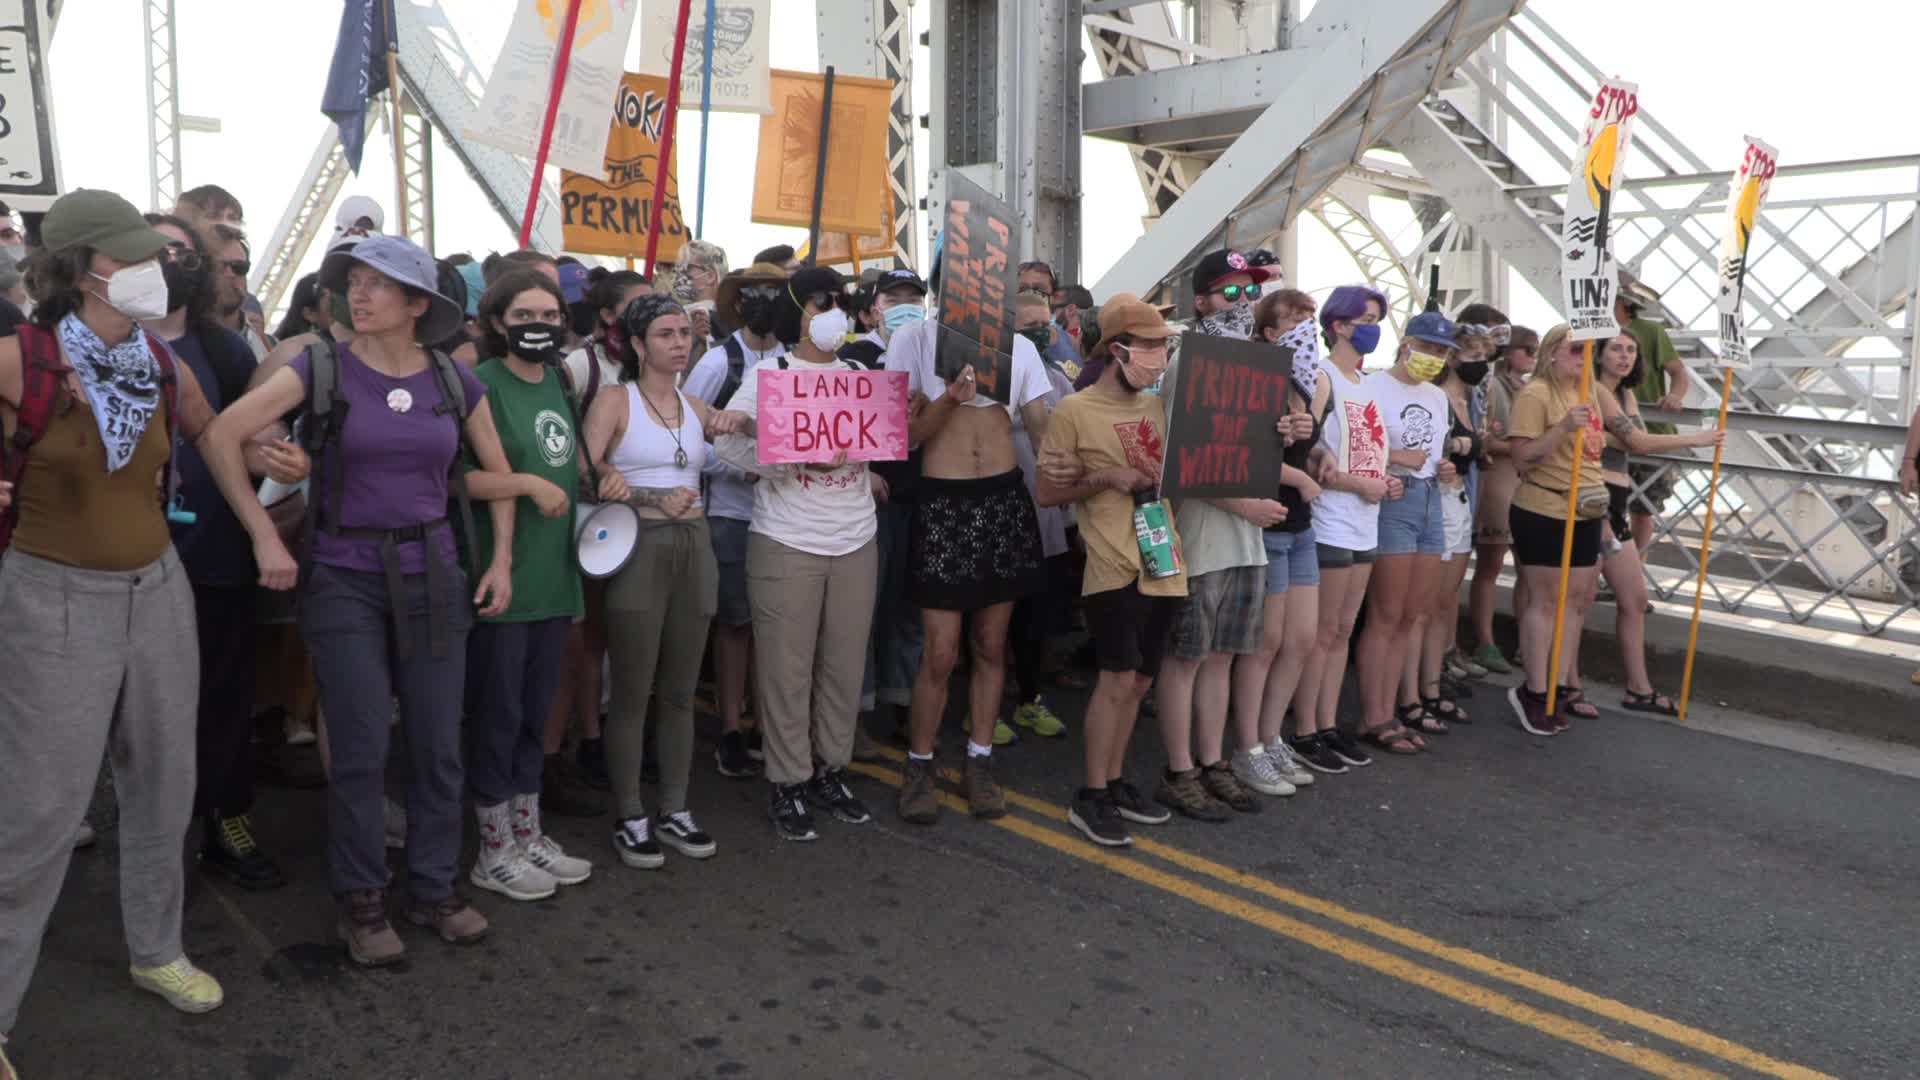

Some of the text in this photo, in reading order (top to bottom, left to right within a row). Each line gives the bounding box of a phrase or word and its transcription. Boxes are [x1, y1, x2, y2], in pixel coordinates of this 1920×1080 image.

[1591, 84, 1638, 125] STOP
[607, 160, 644, 184] THE
[1741, 143, 1776, 186] STOP
[944, 200, 970, 325] WATER
[965, 257, 983, 322] THE
[976, 216, 1009, 394] PROTECT
[793, 374, 873, 400] LAND
[1184, 353, 1286, 416] PROTECT
[793, 409, 879, 452] BACK
[1211, 412, 1247, 442] THE
[1178, 444, 1250, 489] WATER
